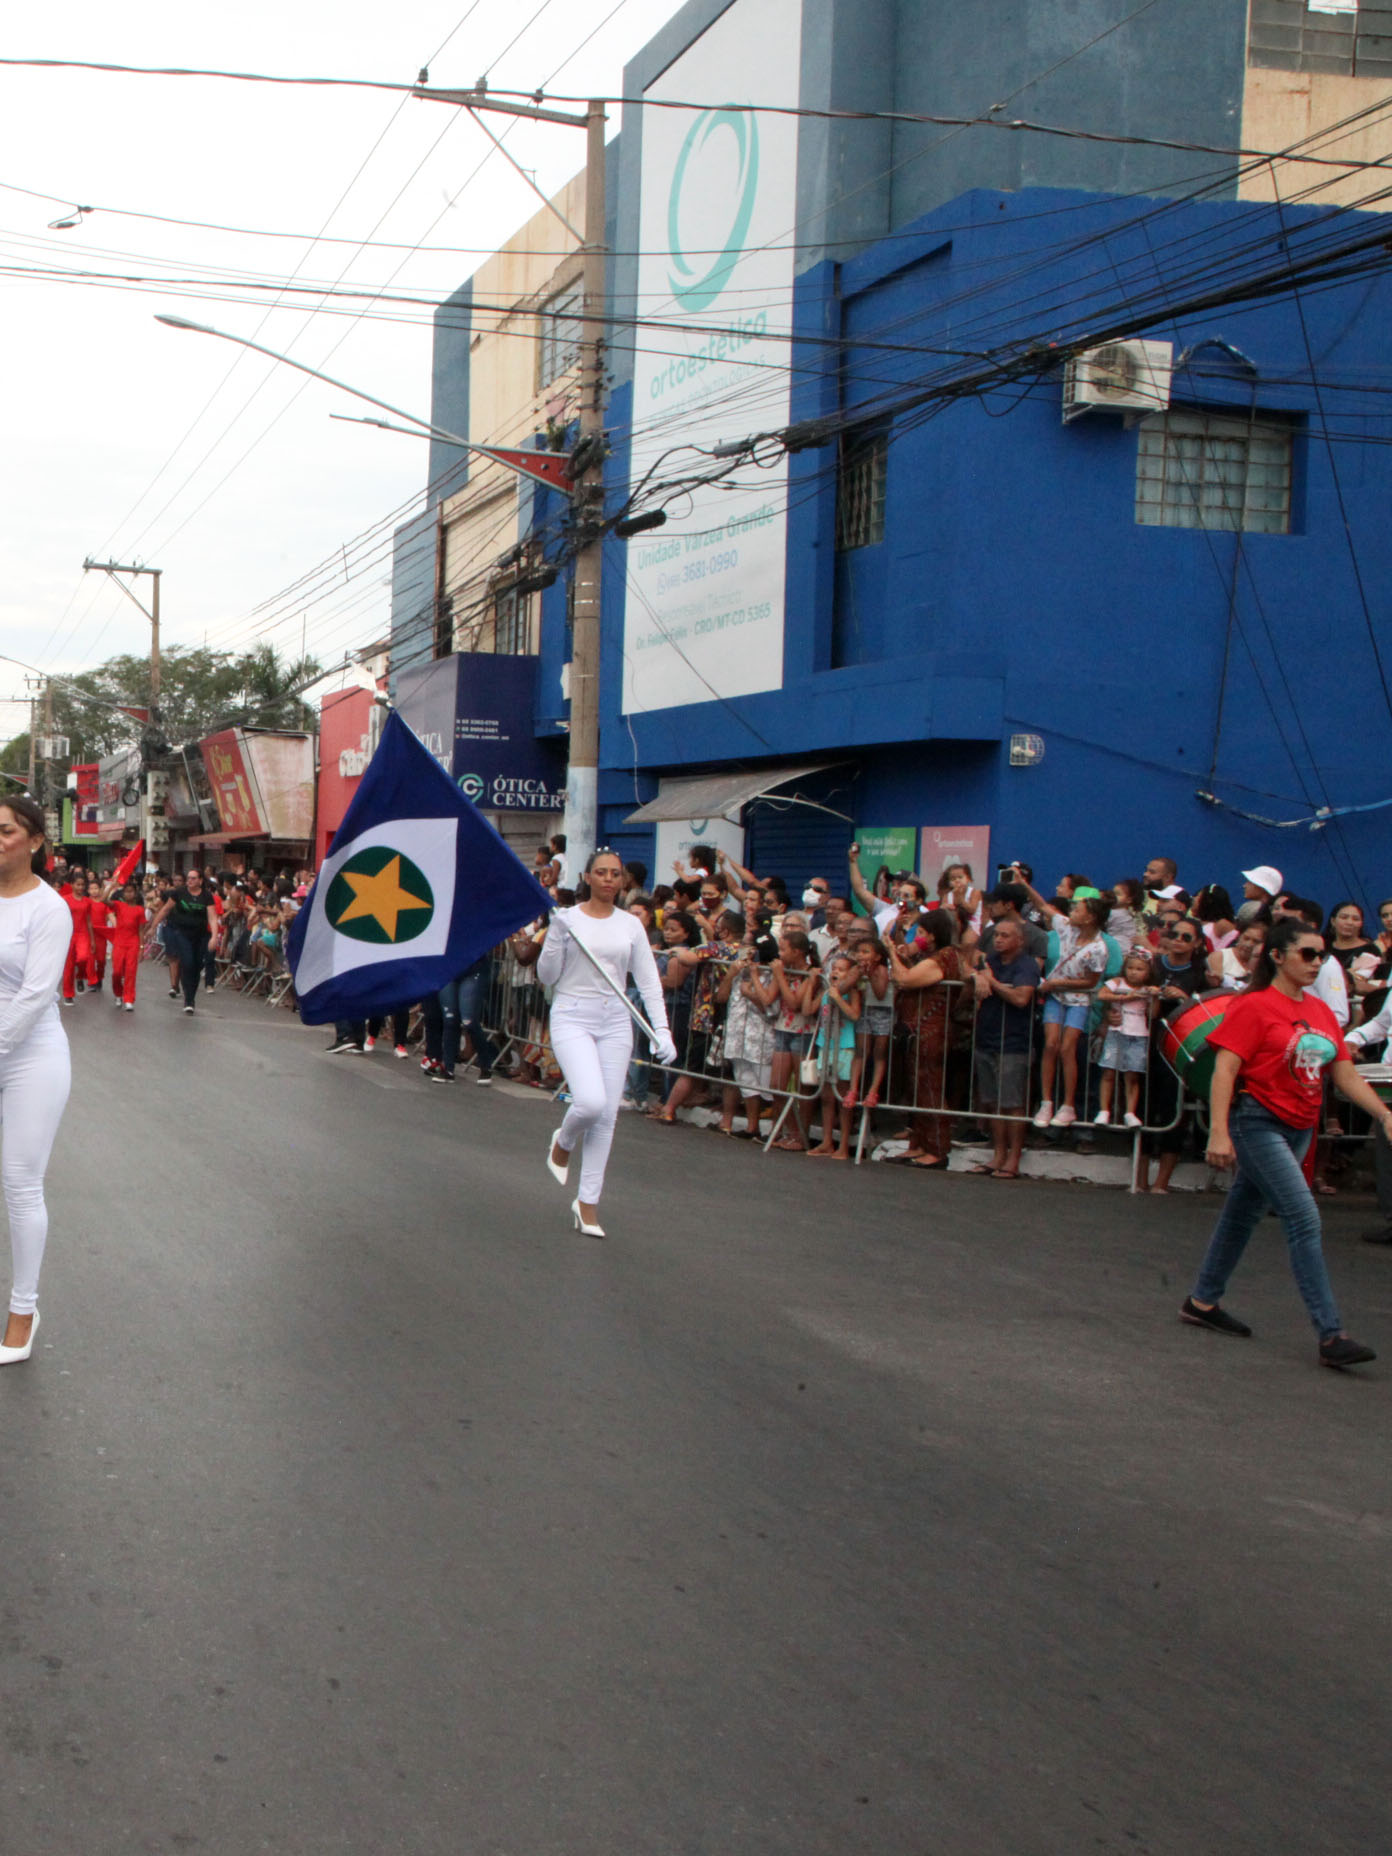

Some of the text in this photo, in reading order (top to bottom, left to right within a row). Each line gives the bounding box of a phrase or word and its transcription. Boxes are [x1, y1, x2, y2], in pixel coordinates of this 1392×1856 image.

[638, 540, 681, 571] Unidade
[726, 503, 775, 538] Grande
[493, 774, 548, 793] ÓTICA
[492, 792, 561, 808] CENTER
